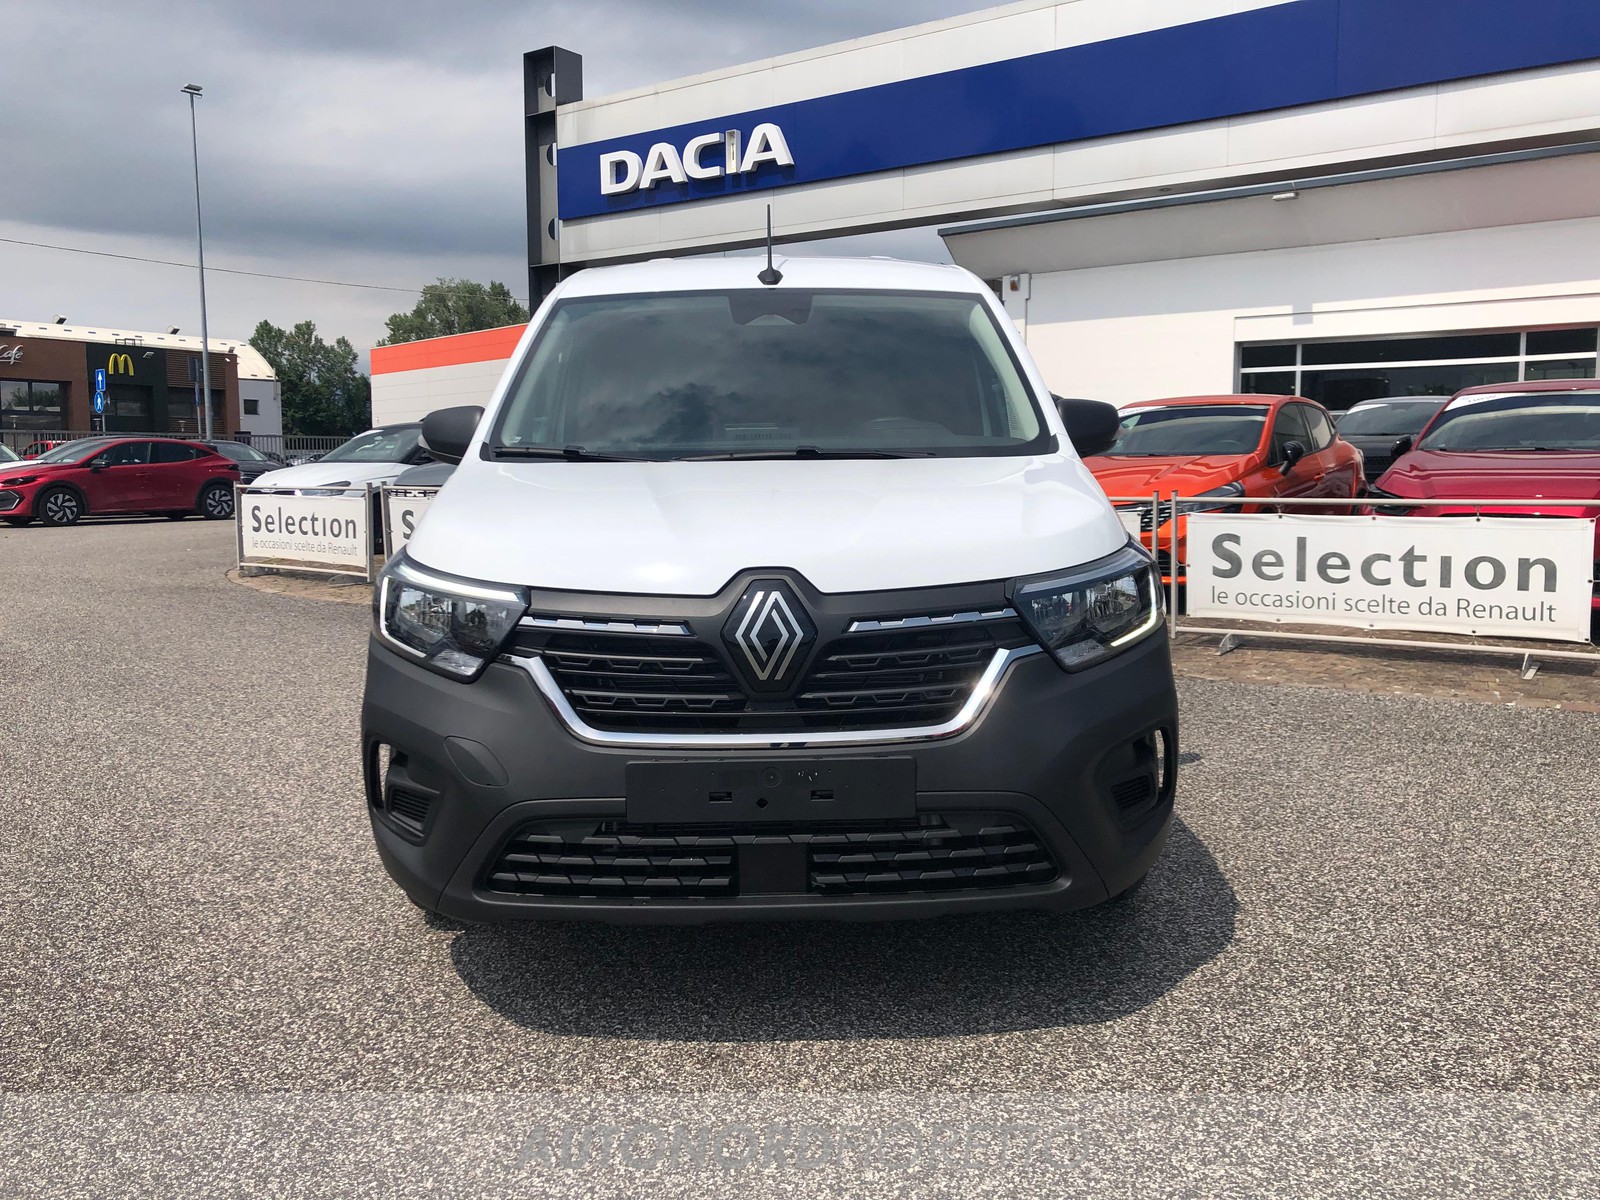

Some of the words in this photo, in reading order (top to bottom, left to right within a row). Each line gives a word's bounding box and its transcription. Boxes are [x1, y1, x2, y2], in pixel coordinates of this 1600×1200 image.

[600, 123, 795, 195] DACIA
[251, 505, 357, 539] Selection
[252, 538, 259, 549] le
[260, 538, 293, 551] occasioni
[294, 540, 316, 552] scelte
[316, 542, 327, 554] da
[328, 544, 358, 556] Renault
[1211, 533, 1558, 593] Selection
[1211, 585, 1229, 606] le
[1235, 589, 1337, 612] occasioni
[1344, 592, 1411, 616] scelte
[1418, 595, 1448, 617] da
[1457, 599, 1557, 623] Renault
